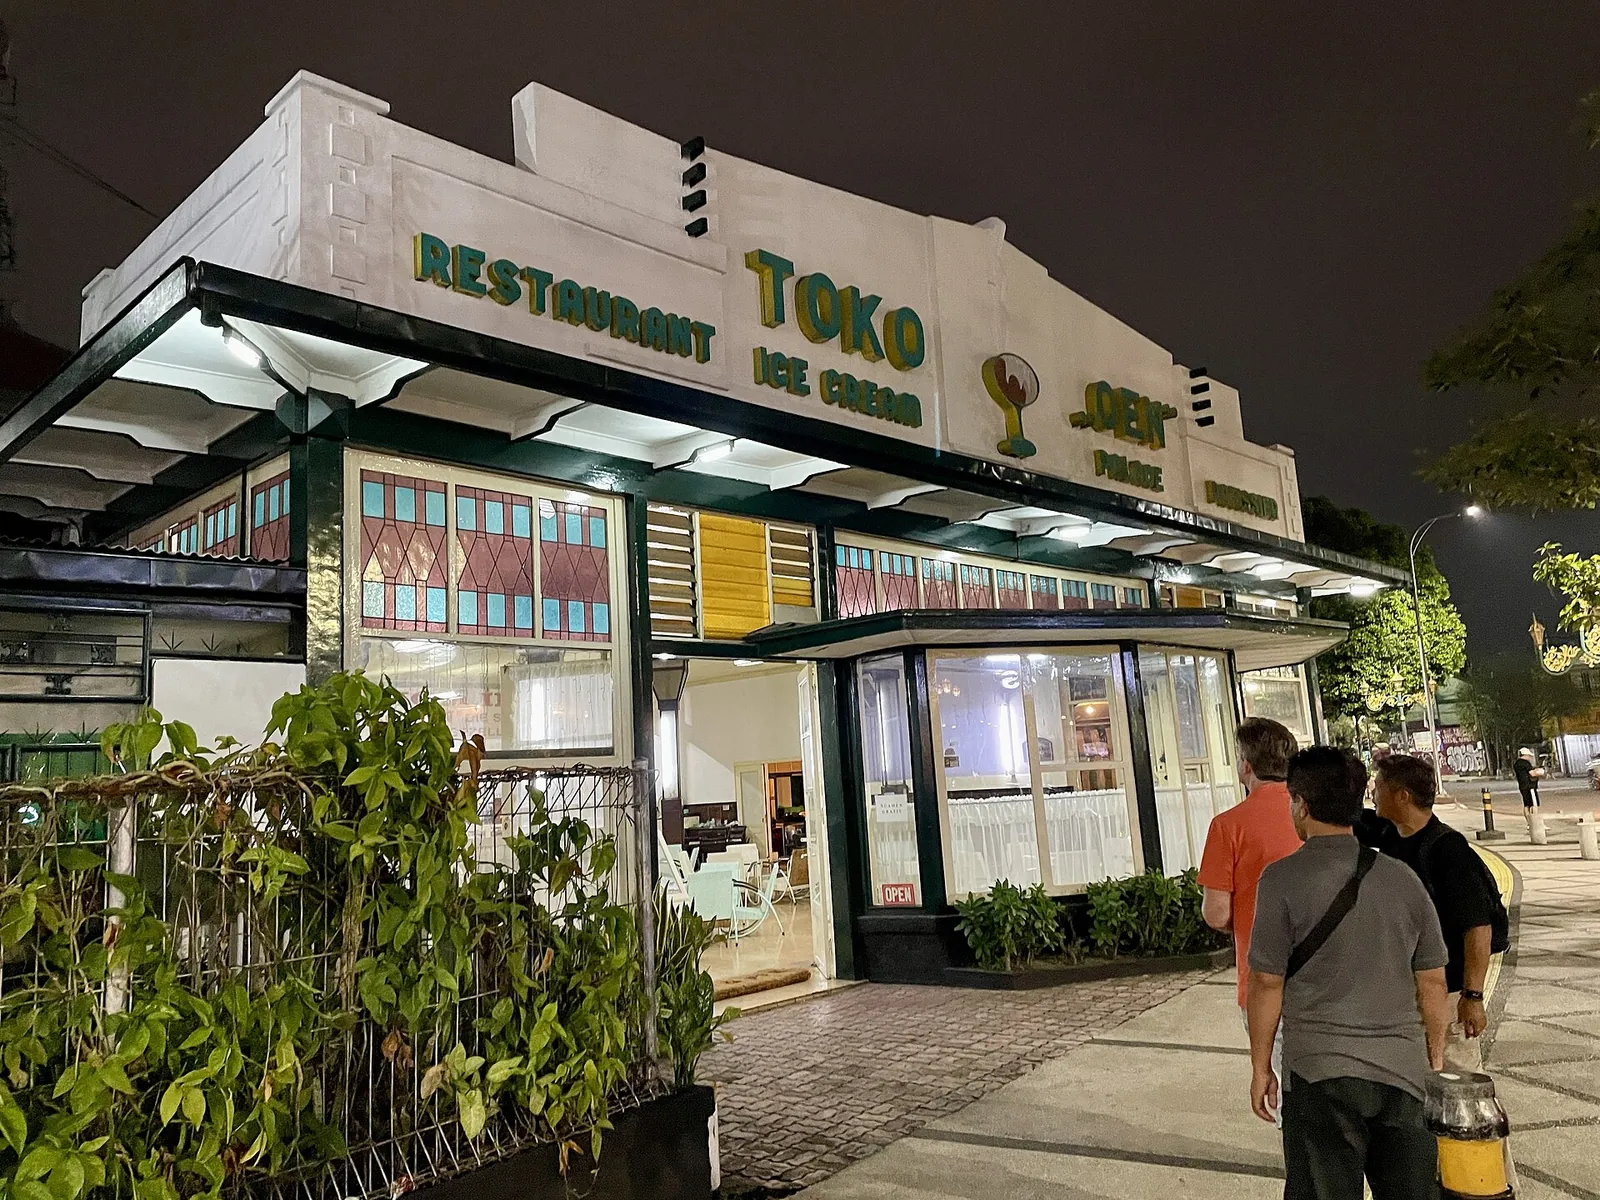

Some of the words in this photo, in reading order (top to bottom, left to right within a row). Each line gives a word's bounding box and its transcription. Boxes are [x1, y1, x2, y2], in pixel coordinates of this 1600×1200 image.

[413, 232, 716, 364] RESTAURANT
[744, 248, 925, 372] TOKO
[753, 346, 811, 397] ICE
[819, 368, 922, 428] CREAM
[885, 887, 912, 903] OPEN
